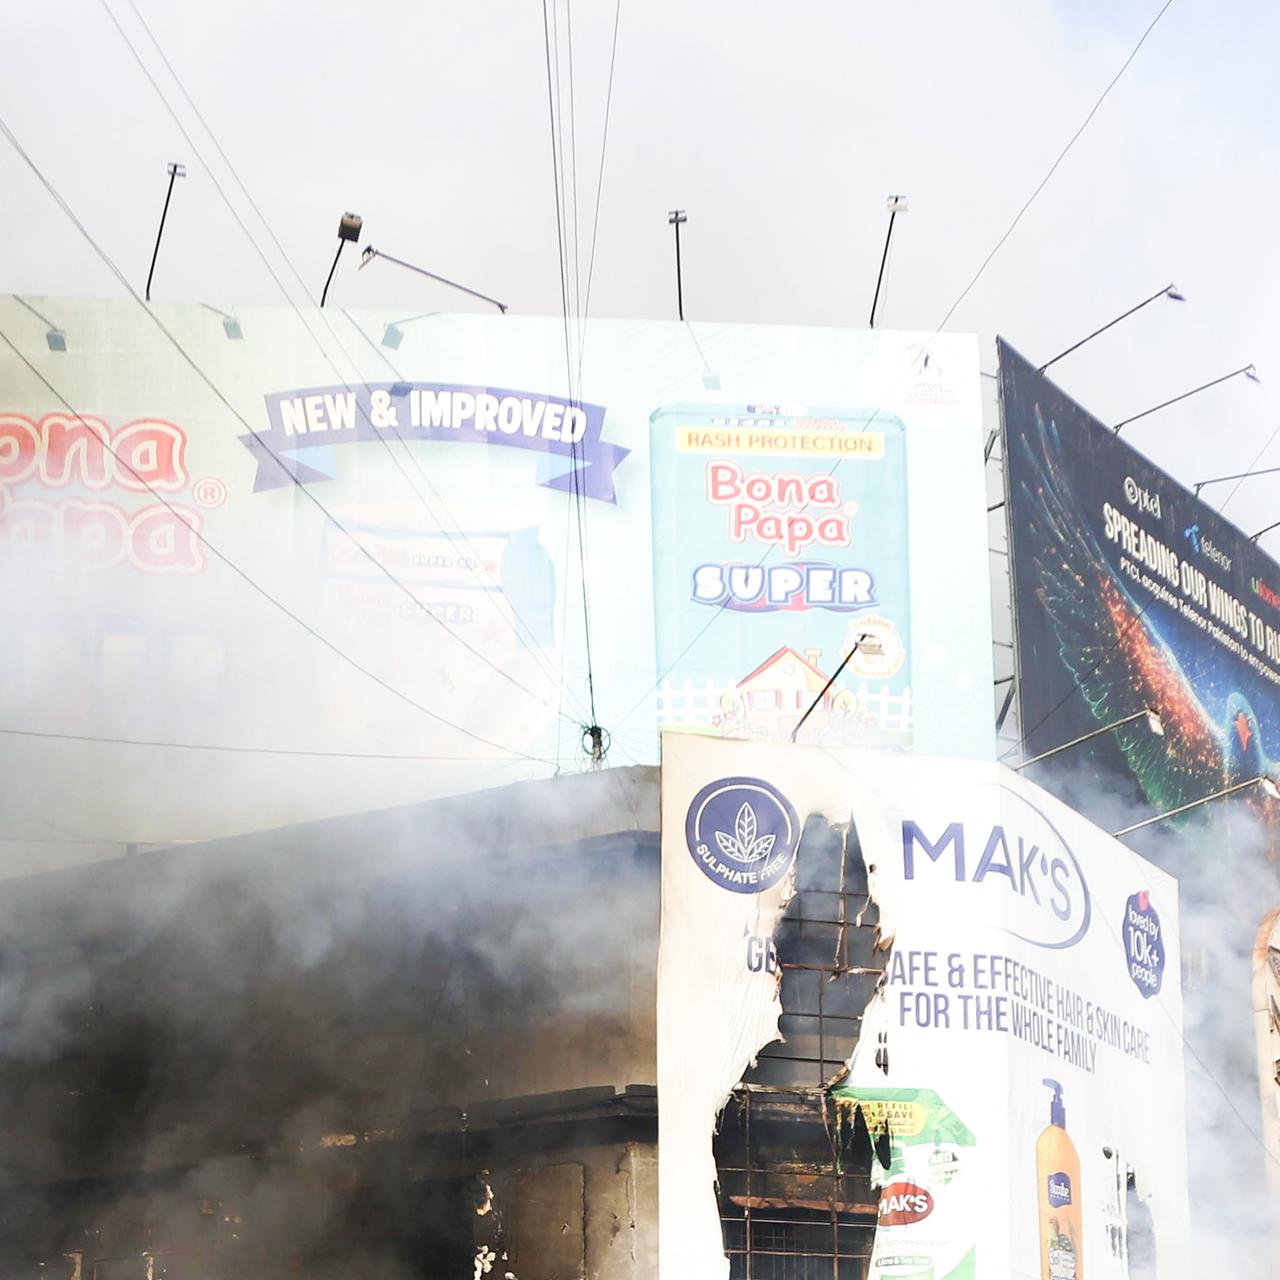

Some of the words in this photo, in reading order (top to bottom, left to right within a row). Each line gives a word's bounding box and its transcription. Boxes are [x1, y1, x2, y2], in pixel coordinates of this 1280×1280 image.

[279, 393, 356, 437] NEW
[370, 391, 399, 429] &
[410, 390, 587, 444] IMPROVED
[687, 432, 741, 448] RASH
[748, 434, 874, 452] PROTECTION
[707, 462, 838, 506] Bona
[729, 502, 851, 556] Papa
[691, 563, 877, 606] SUPER
[1103, 502, 1180, 588] SPREADING
[1180, 560, 1209, 609] OUR
[1208, 580, 1248, 639] WINGS
[1248, 611, 1265, 651] TO
[695, 843, 759, 885] SULPHATE
[759, 851, 788, 881] FREE
[900, 819, 1072, 922] MAK'S
[1128, 904, 1149, 932] loved
[1149, 916, 1160, 942] by
[1128, 925, 1160, 968] 10k+
[1131, 961, 1157, 988] people
[885, 950, 938, 987] AFE
[947, 953, 966, 988] &
[972, 953, 1054, 1015] EFFECTIVE
[1056, 981, 1084, 1026] HAIR
[1085, 999, 1095, 1026] &
[1095, 1005, 1122, 1049] SKIN
[1122, 1020, 1151, 1065] CARE
[899, 991, 951, 1028] FOR
[961, 994, 1009, 1033] THE
[1010, 999, 1055, 1056] WHOLE
[1056, 1024, 1098, 1075] FAMILY
